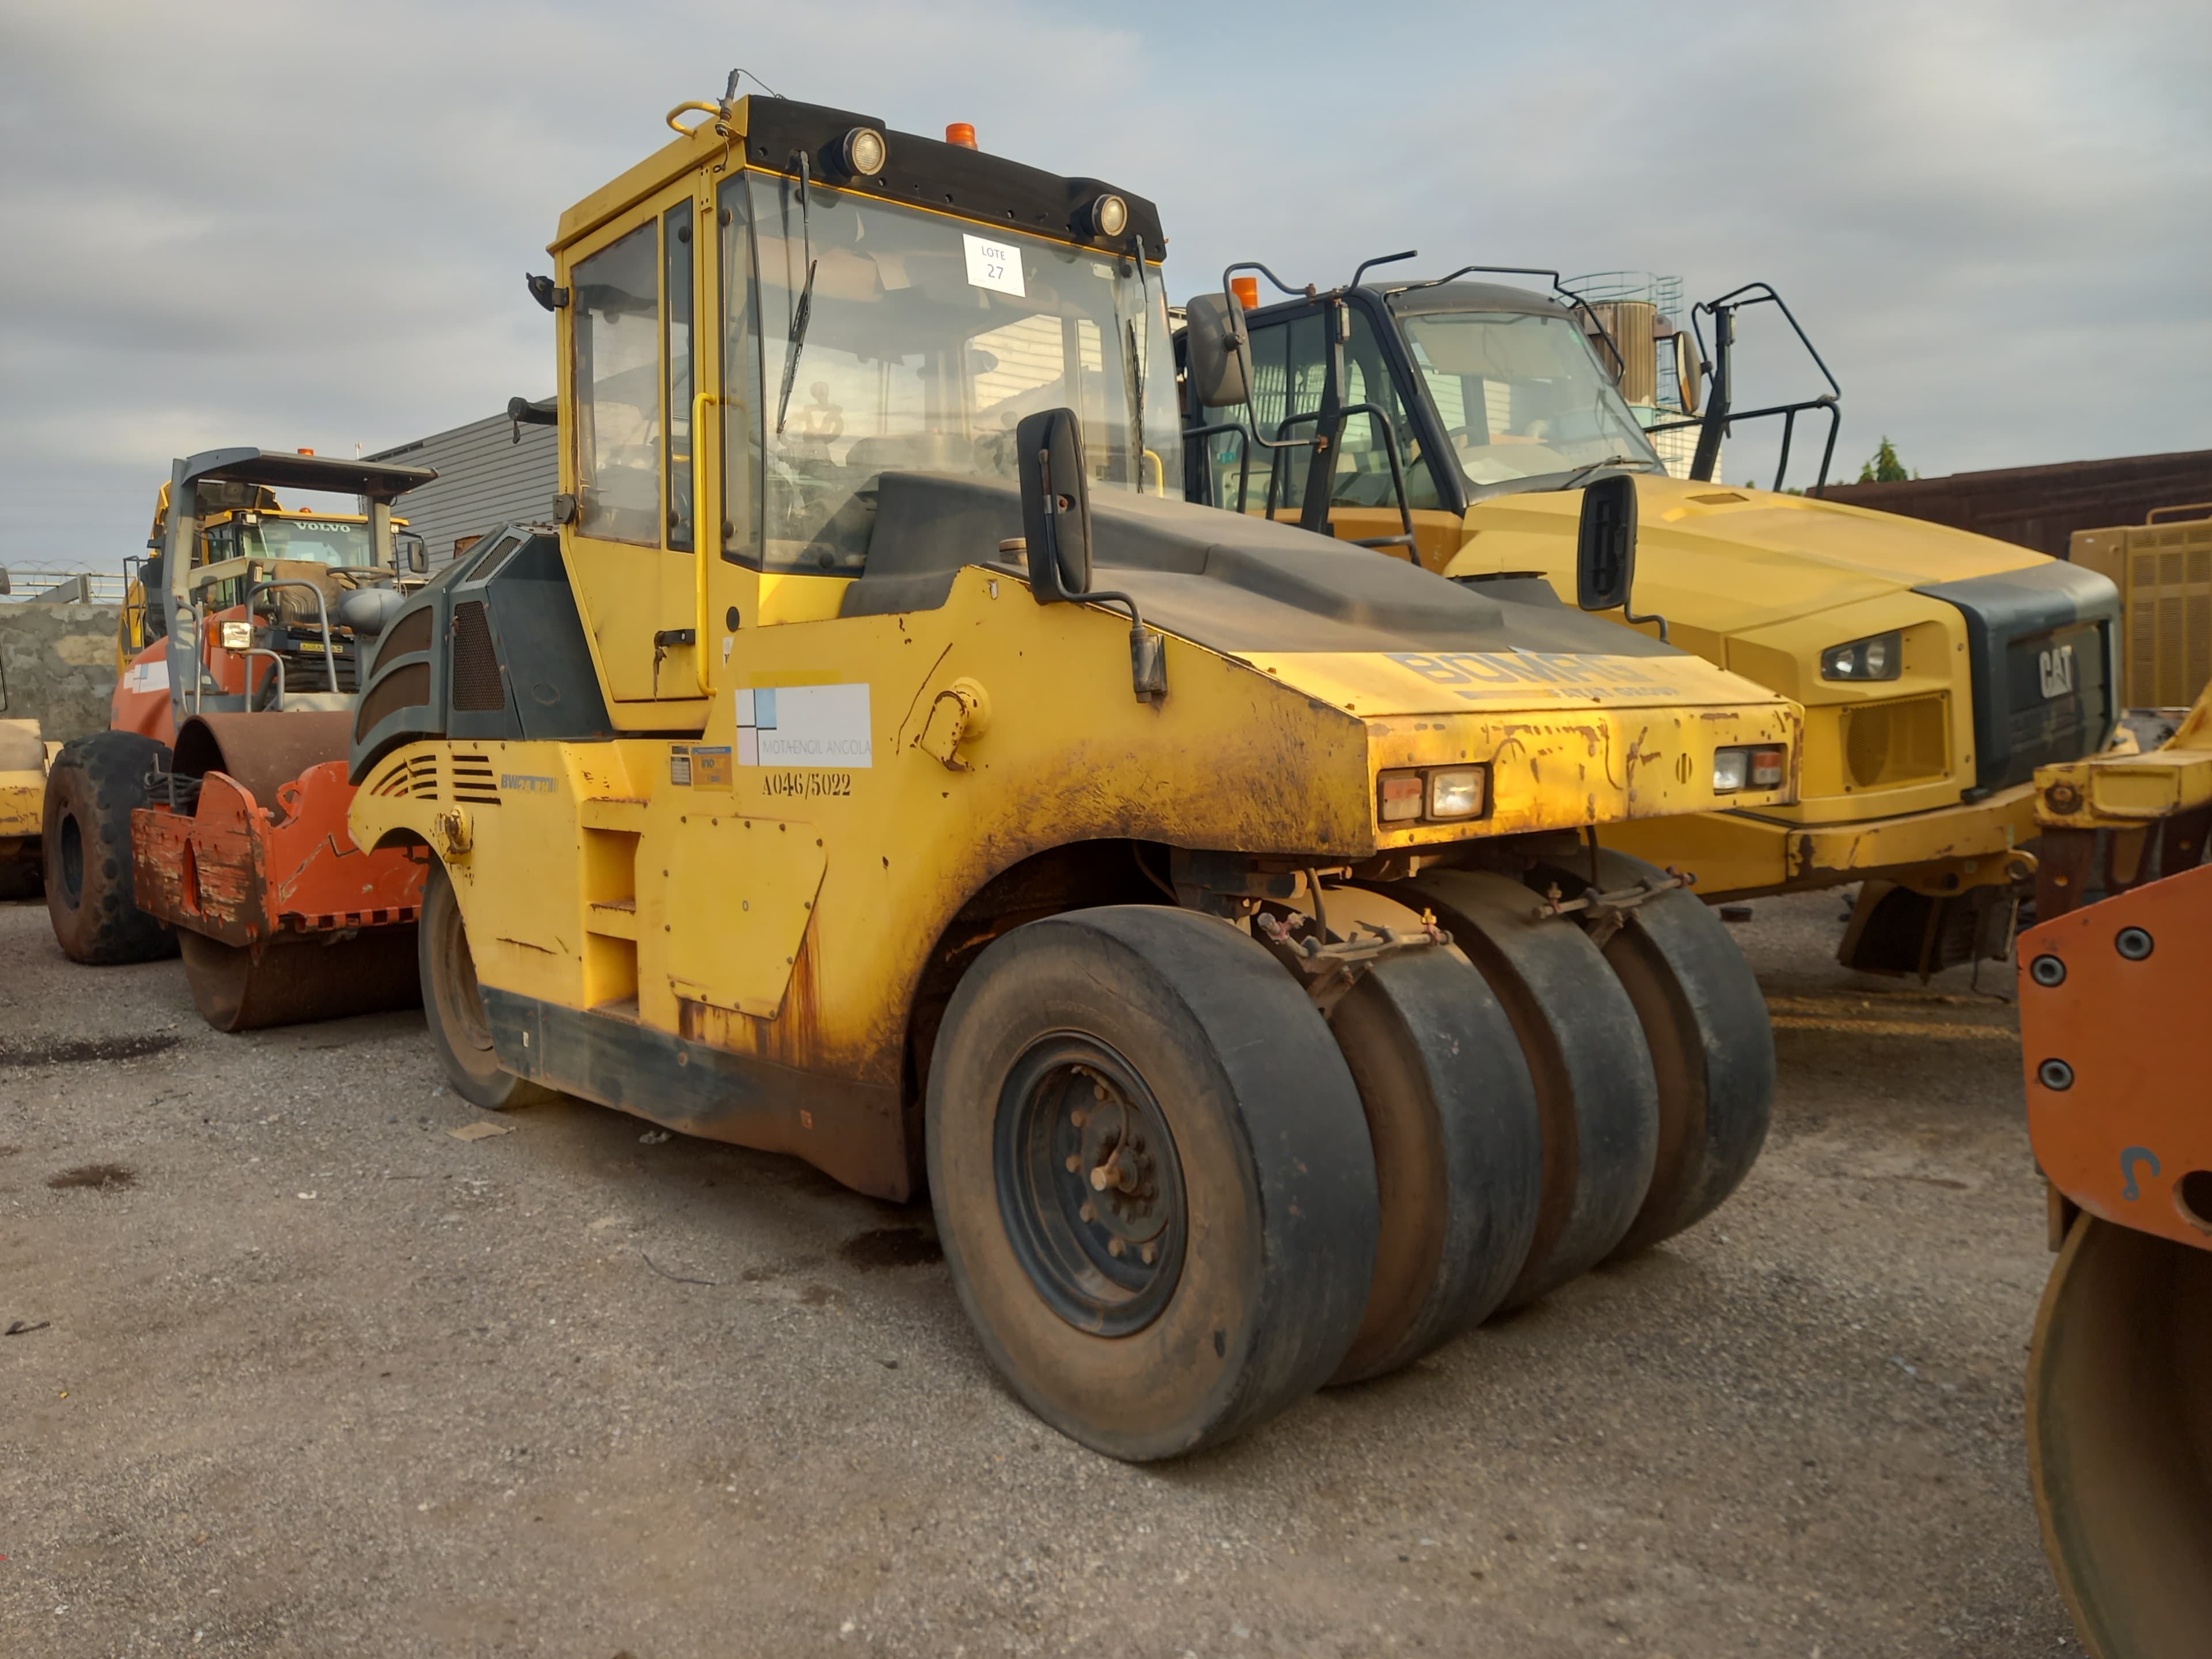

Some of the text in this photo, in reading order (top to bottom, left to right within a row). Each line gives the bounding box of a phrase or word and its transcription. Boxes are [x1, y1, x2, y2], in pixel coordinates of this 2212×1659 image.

[982, 246, 1006, 260] LOTE
[987, 264, 1003, 279] 27
[293, 522, 351, 533] VOLVO
[1383, 652, 1656, 685] BOMAG
[2040, 645, 2073, 698] CAT
[826, 740, 872, 755] ANGOLA
[762, 772, 850, 800] A046/5022
